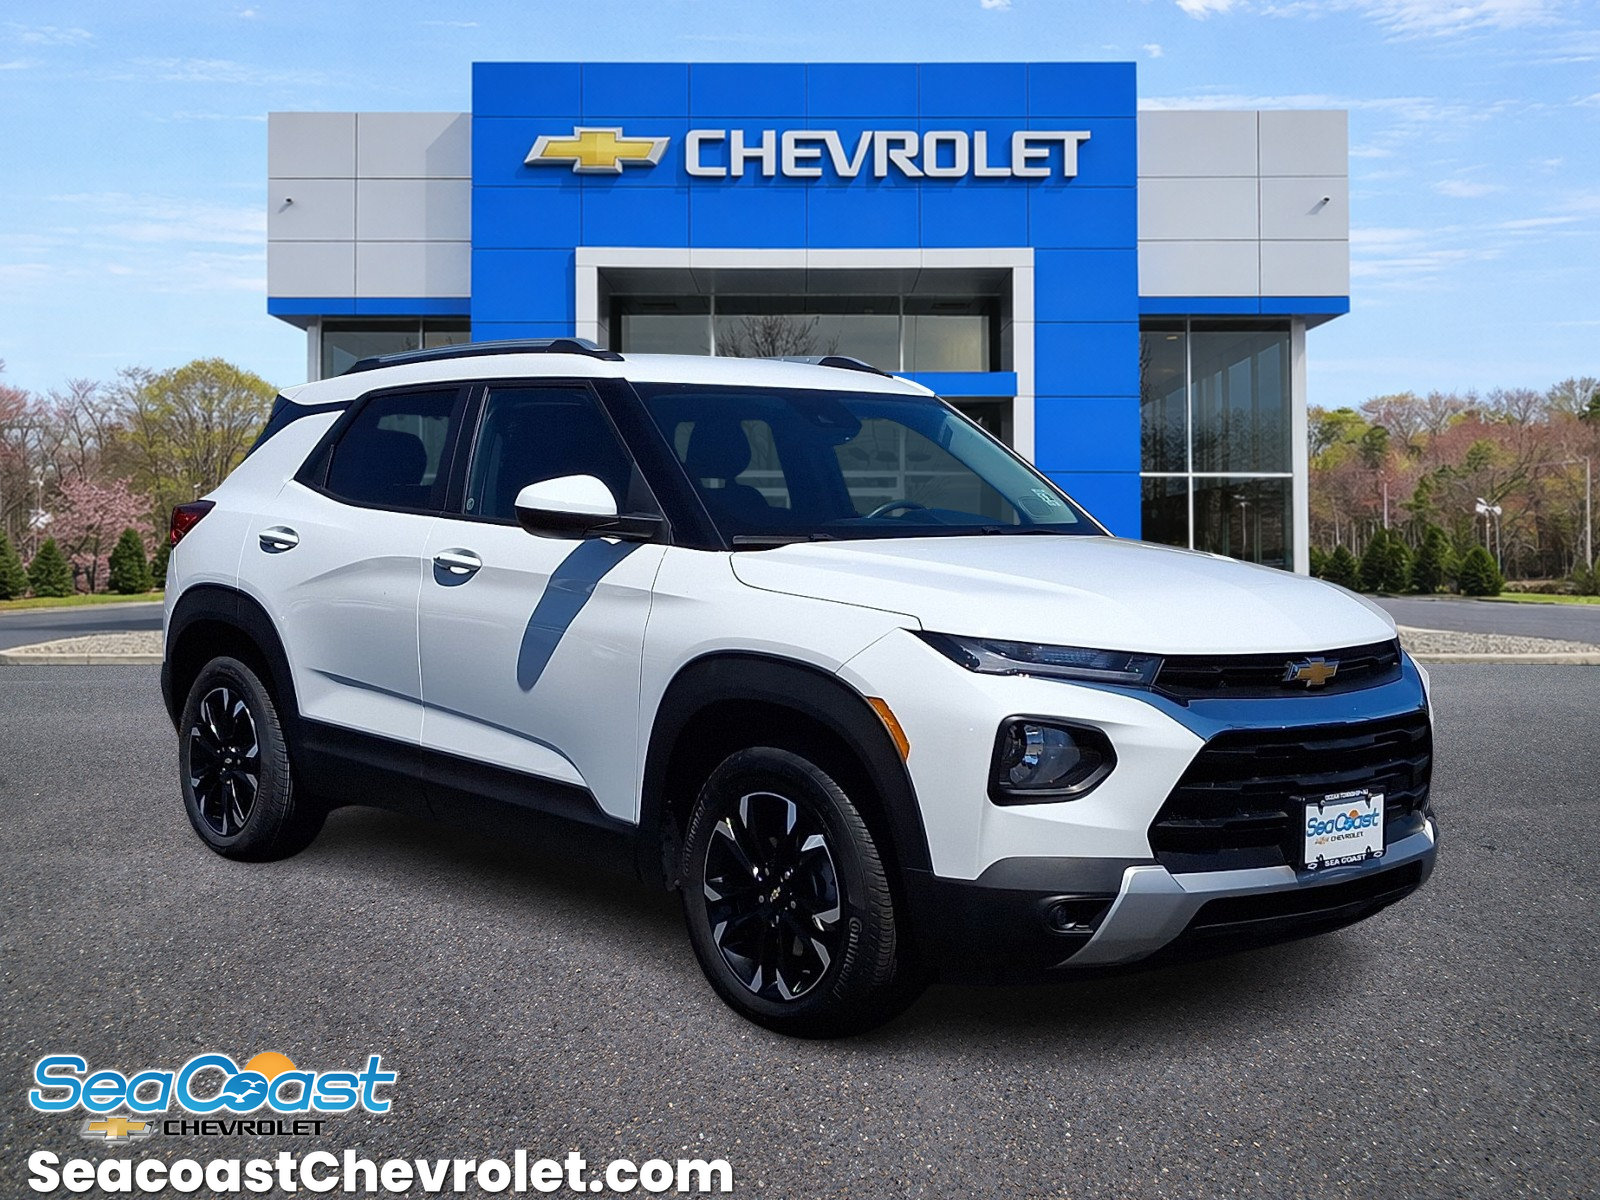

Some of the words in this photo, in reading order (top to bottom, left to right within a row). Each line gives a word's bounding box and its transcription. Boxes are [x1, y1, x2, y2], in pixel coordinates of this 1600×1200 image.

[685, 129, 1091, 178] CHEVROLET
[1330, 831, 1364, 842] CHEVROLET
[1325, 858, 1340, 867] SEA
[1341, 853, 1367, 864] COAST
